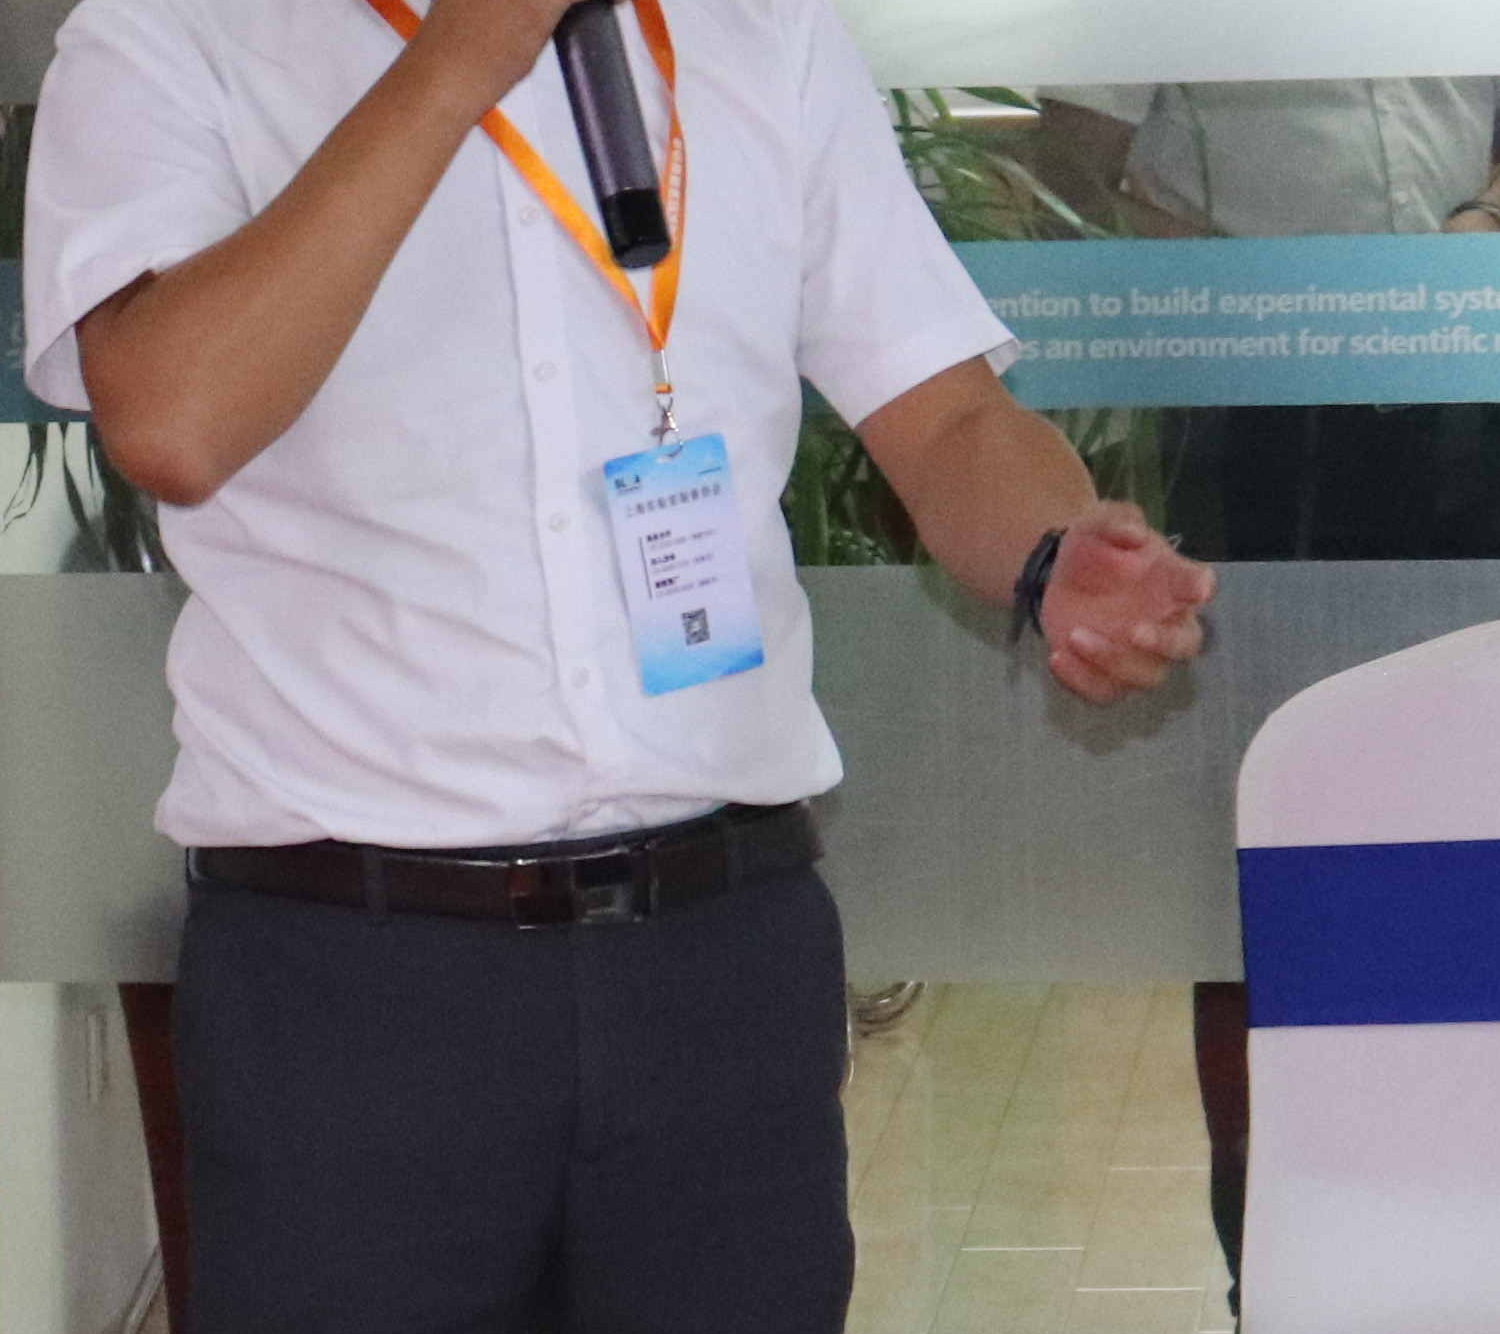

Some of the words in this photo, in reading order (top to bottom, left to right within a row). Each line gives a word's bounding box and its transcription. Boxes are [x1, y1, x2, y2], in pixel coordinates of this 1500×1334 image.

[1090, 293, 1122, 317] to
[1131, 287, 1210, 315] build
[1218, 283, 1427, 321] experimental
[1045, 339, 1083, 360] an
[1089, 329, 1291, 359] environment
[1299, 326, 1343, 355] for
[1351, 324, 1488, 354] scientific
